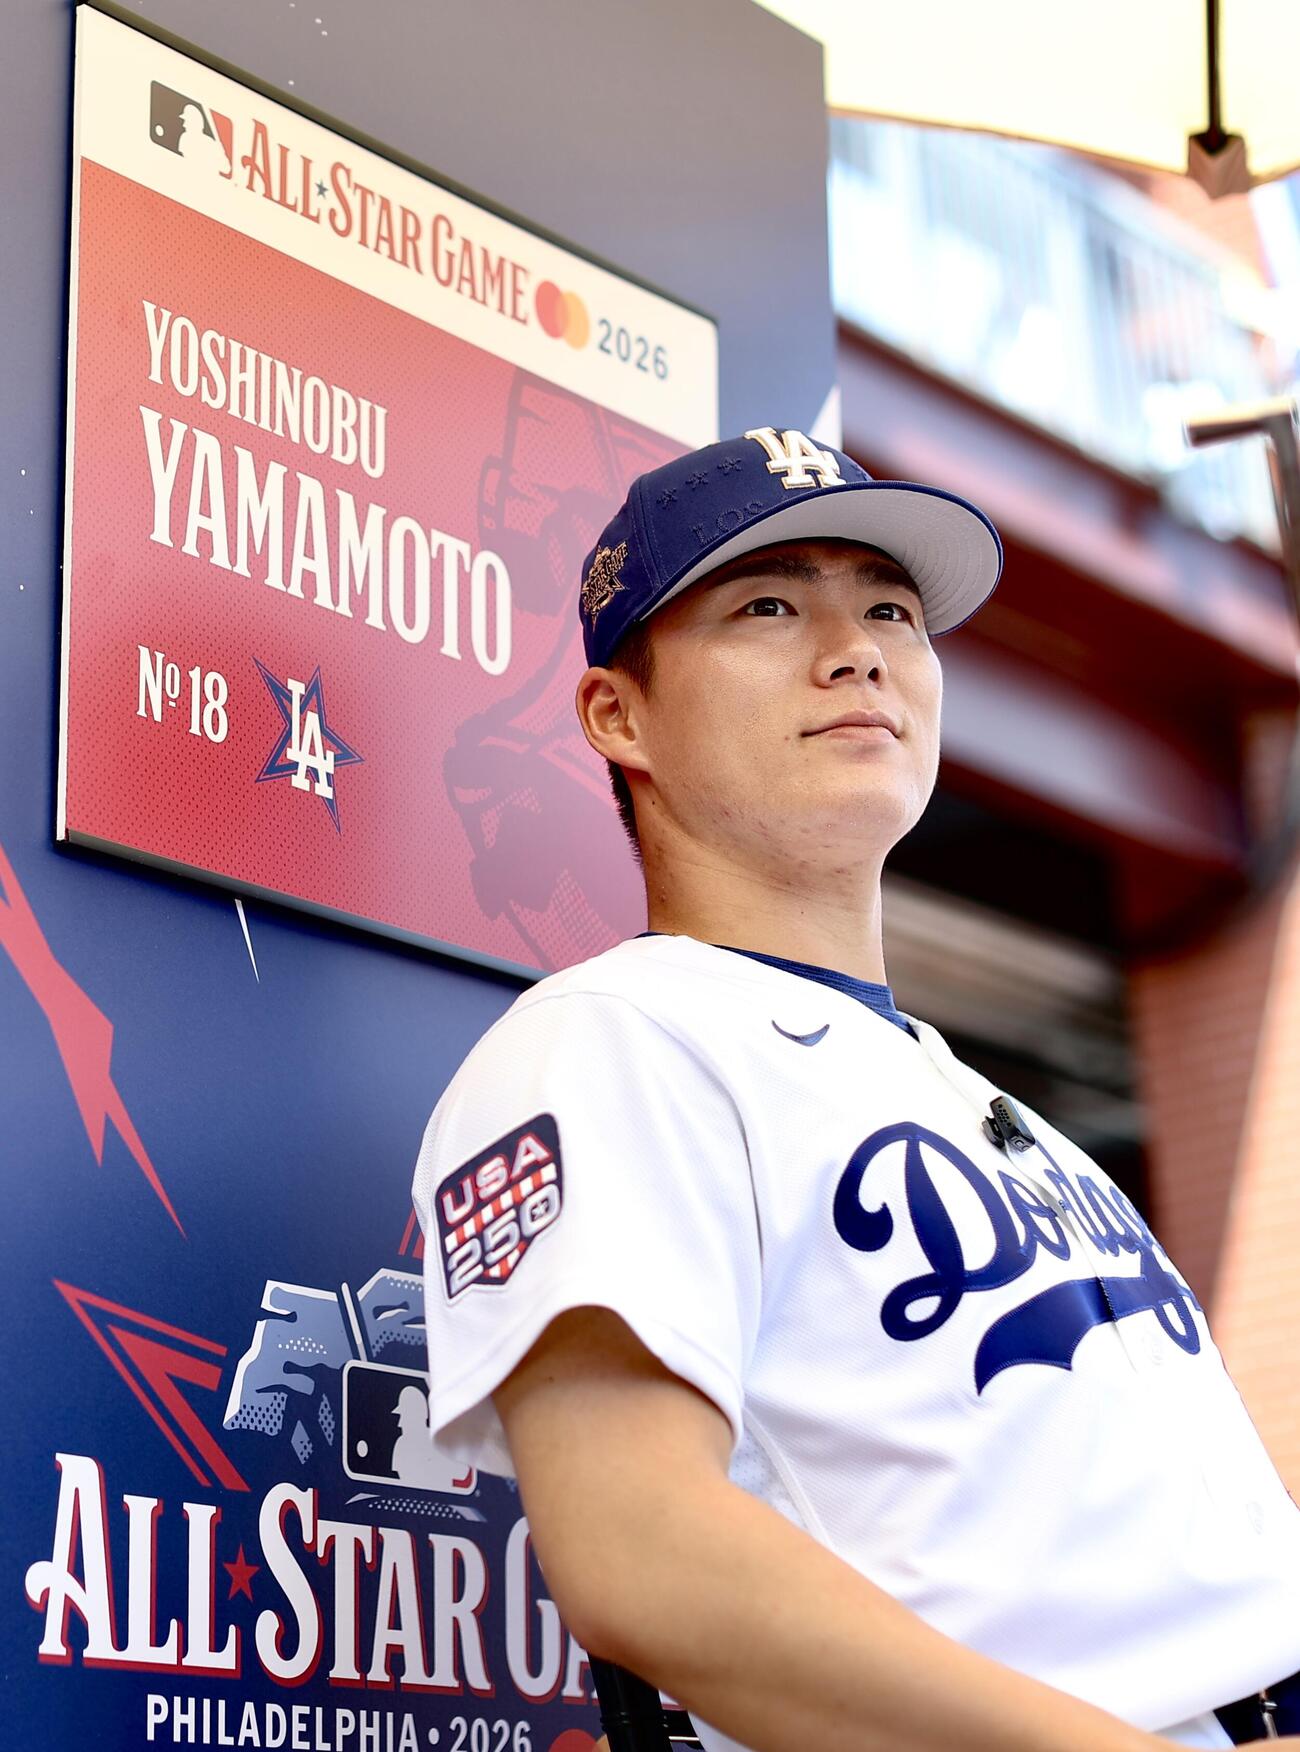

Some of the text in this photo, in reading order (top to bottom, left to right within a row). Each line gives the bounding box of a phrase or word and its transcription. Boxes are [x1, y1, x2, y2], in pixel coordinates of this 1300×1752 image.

[241, 118, 669, 381] ALL STAR GAME 2026
[142, 299, 388, 478] YOSHINOBU
[744, 426, 847, 490] LA
[139, 405, 512, 675] YAMAMOTO
[188, 665, 229, 743] 18
[287, 678, 335, 799] LA
[442, 1133, 552, 1226] USA
[447, 1183, 561, 1297] 250
[25, 1452, 241, 1678] ALL
[255, 1482, 498, 1699] STAR
[146, 1693, 532, 1752] PHILADELPHIA 2026
